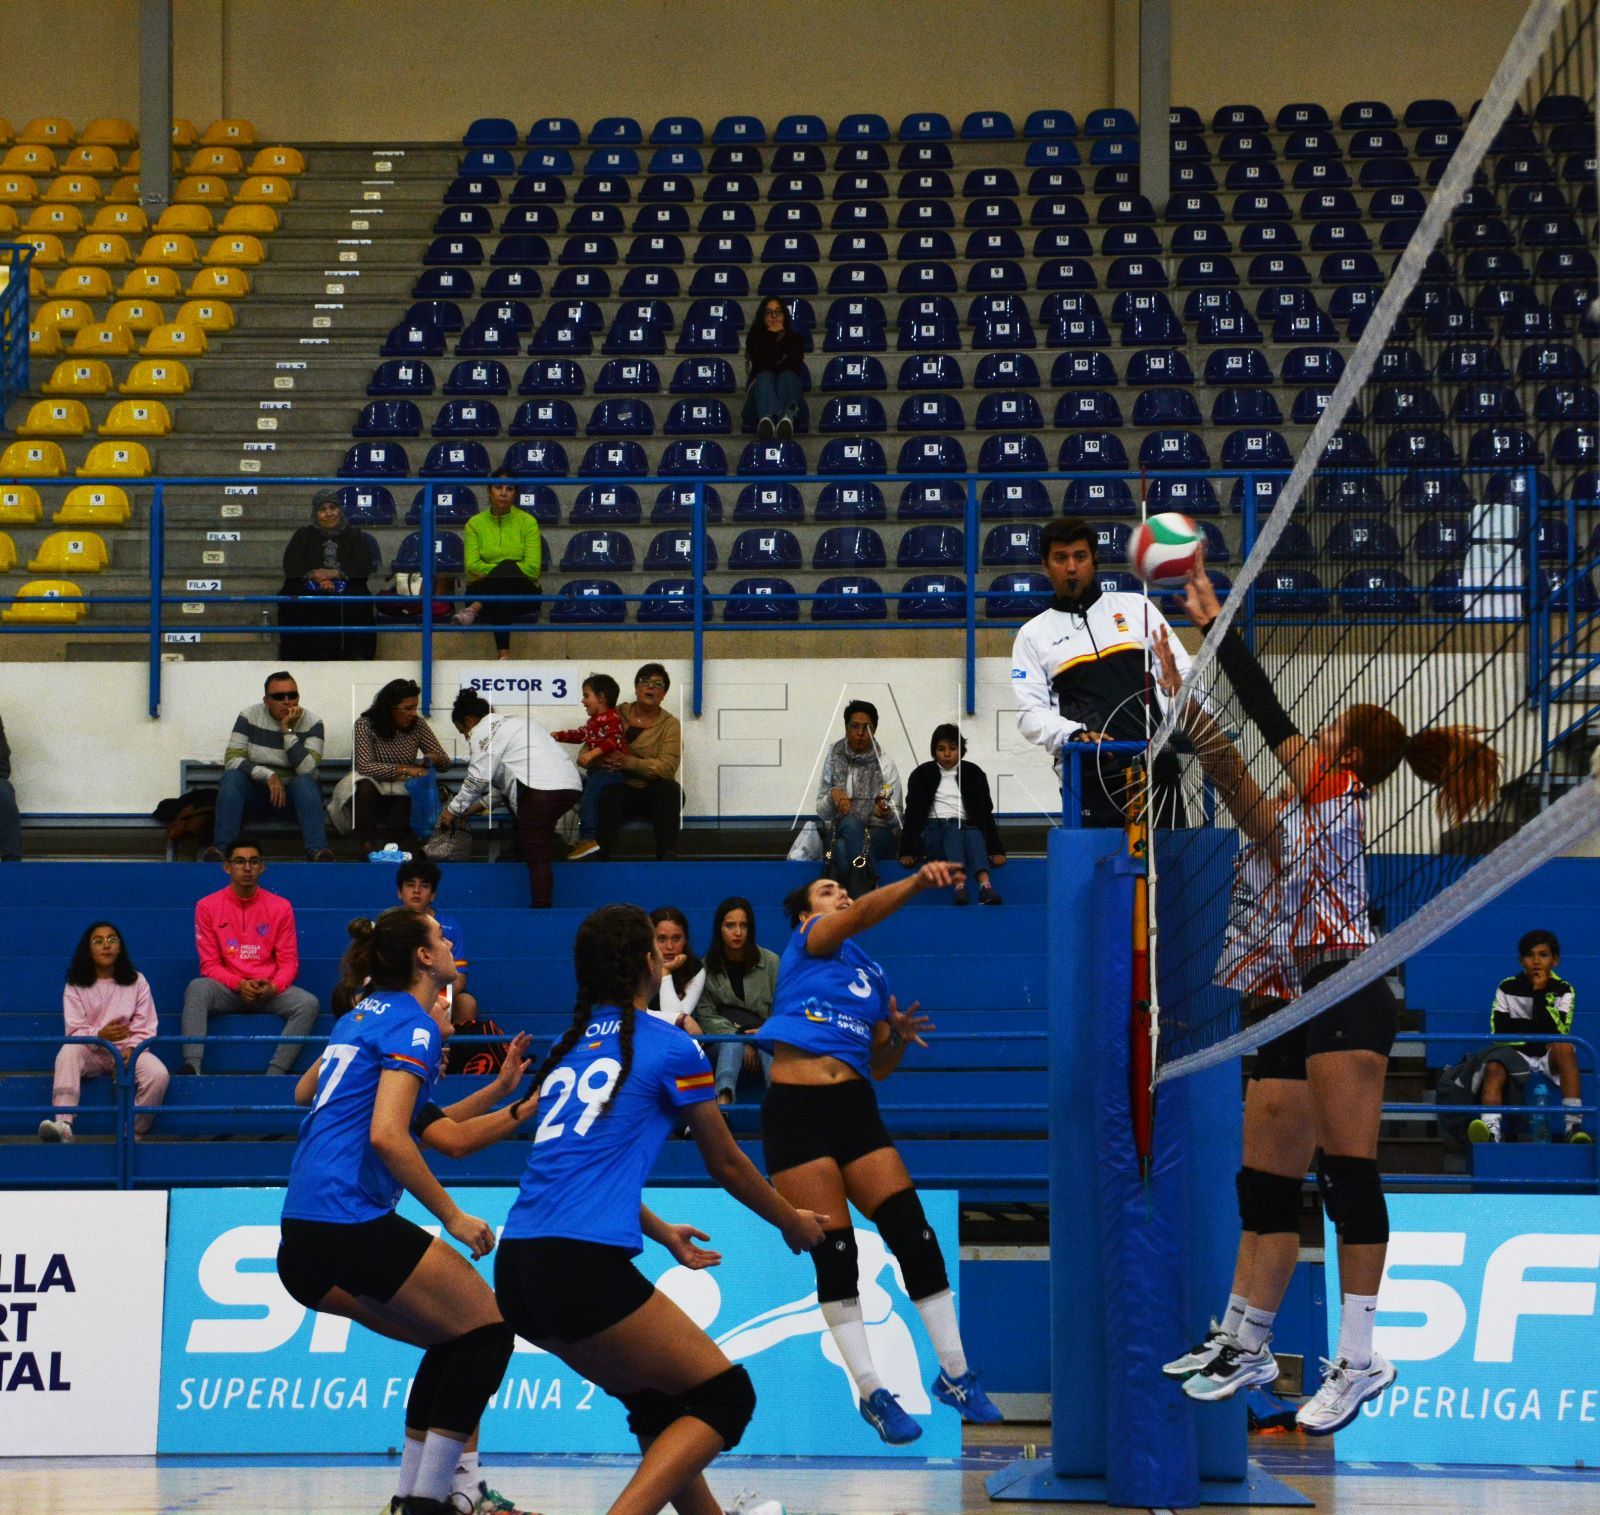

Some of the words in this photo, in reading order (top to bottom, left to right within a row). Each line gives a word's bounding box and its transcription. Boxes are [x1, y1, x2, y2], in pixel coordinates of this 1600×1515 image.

[1208, 296, 1218, 304] 12
[1072, 322, 1083, 330] 10
[1222, 319, 1233, 327] 12
[1076, 360, 1088, 368] 10
[1152, 358, 1162, 366] 11
[1229, 357, 1241, 365] 12
[1307, 356, 1318, 364] 13
[1081, 399, 1093, 408] 10
[1086, 441, 1098, 449] 10
[1166, 440, 1177, 448] 11
[1249, 438, 1261, 447] 12
[1091, 486, 1103, 494] 10
[1174, 485, 1185, 493] 11
[1258, 483, 1271, 491] 12
[210, 582, 218, 591] 2
[1103, 582, 1116, 591] 10
[470, 678, 542, 691] SECTOR
[551, 678, 568, 698] 3
[847, 967, 872, 998] 3
[533, 1057, 622, 1145] 29
[176, 1377, 368, 1410] SUPERLIGA
[575, 1379, 596, 1410] 2
[1363, 1385, 1542, 1421] UPERLIGA
[1558, 1389, 1600, 1422] FE
